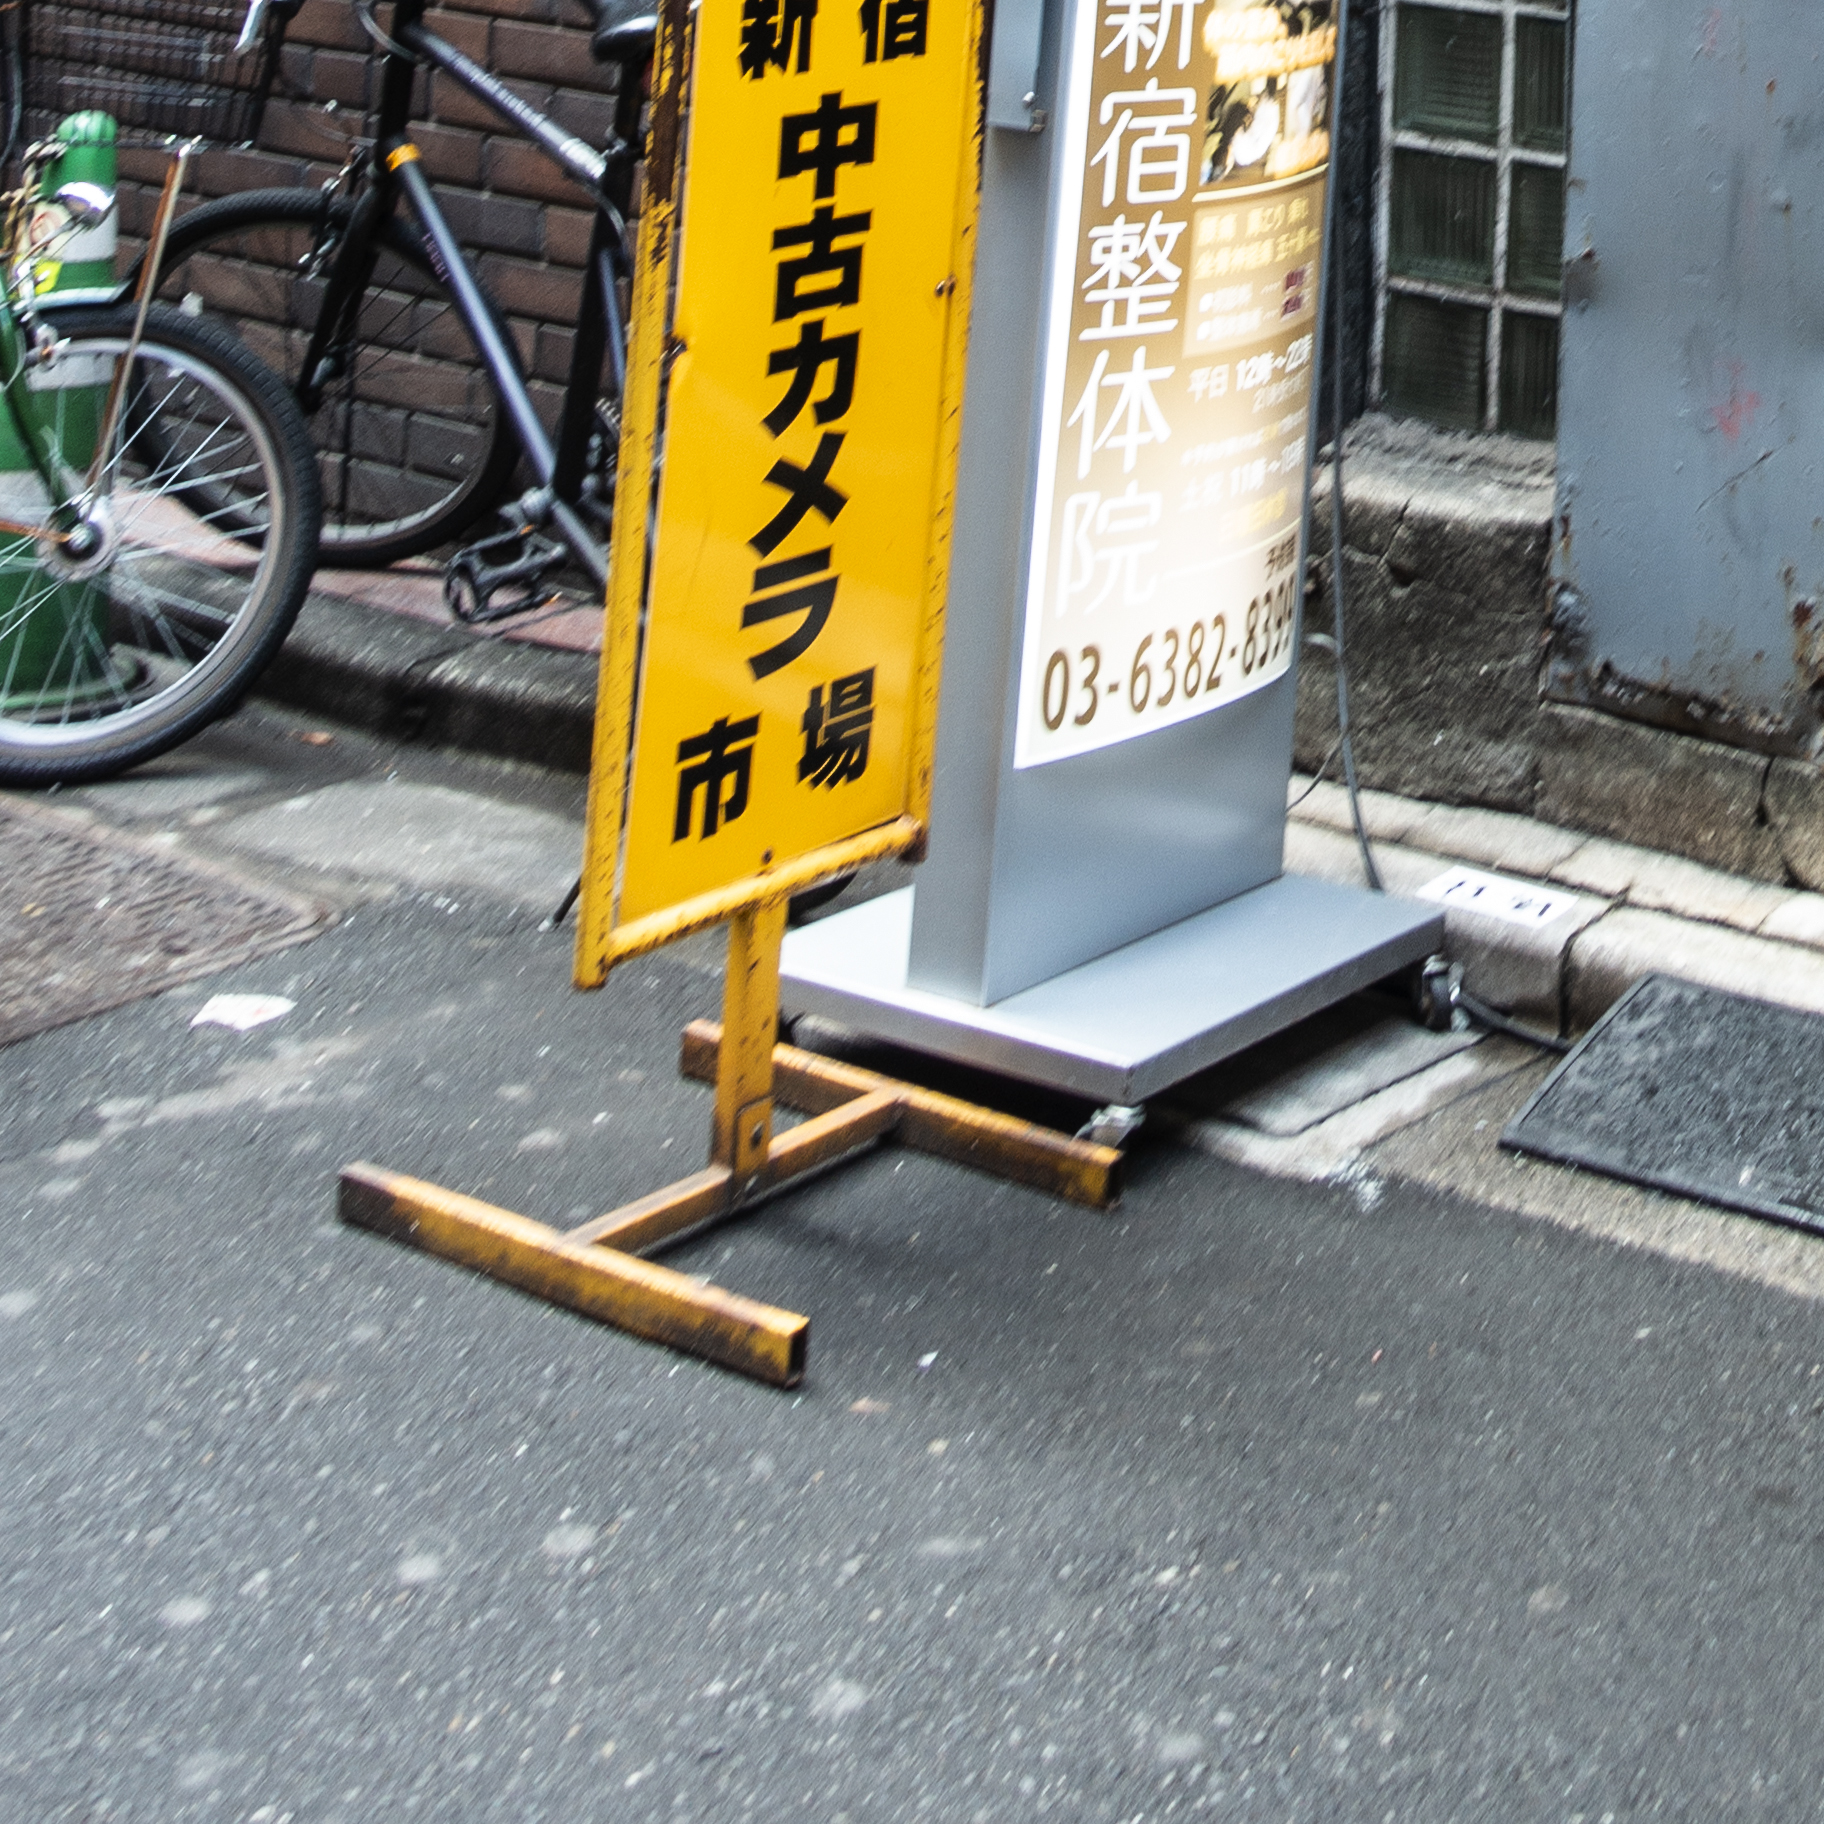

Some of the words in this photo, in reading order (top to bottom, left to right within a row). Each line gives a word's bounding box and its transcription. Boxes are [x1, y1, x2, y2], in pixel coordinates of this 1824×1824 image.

[740, 93, 880, 683] 中古カメラ
[672, 664, 877, 844] 市場
